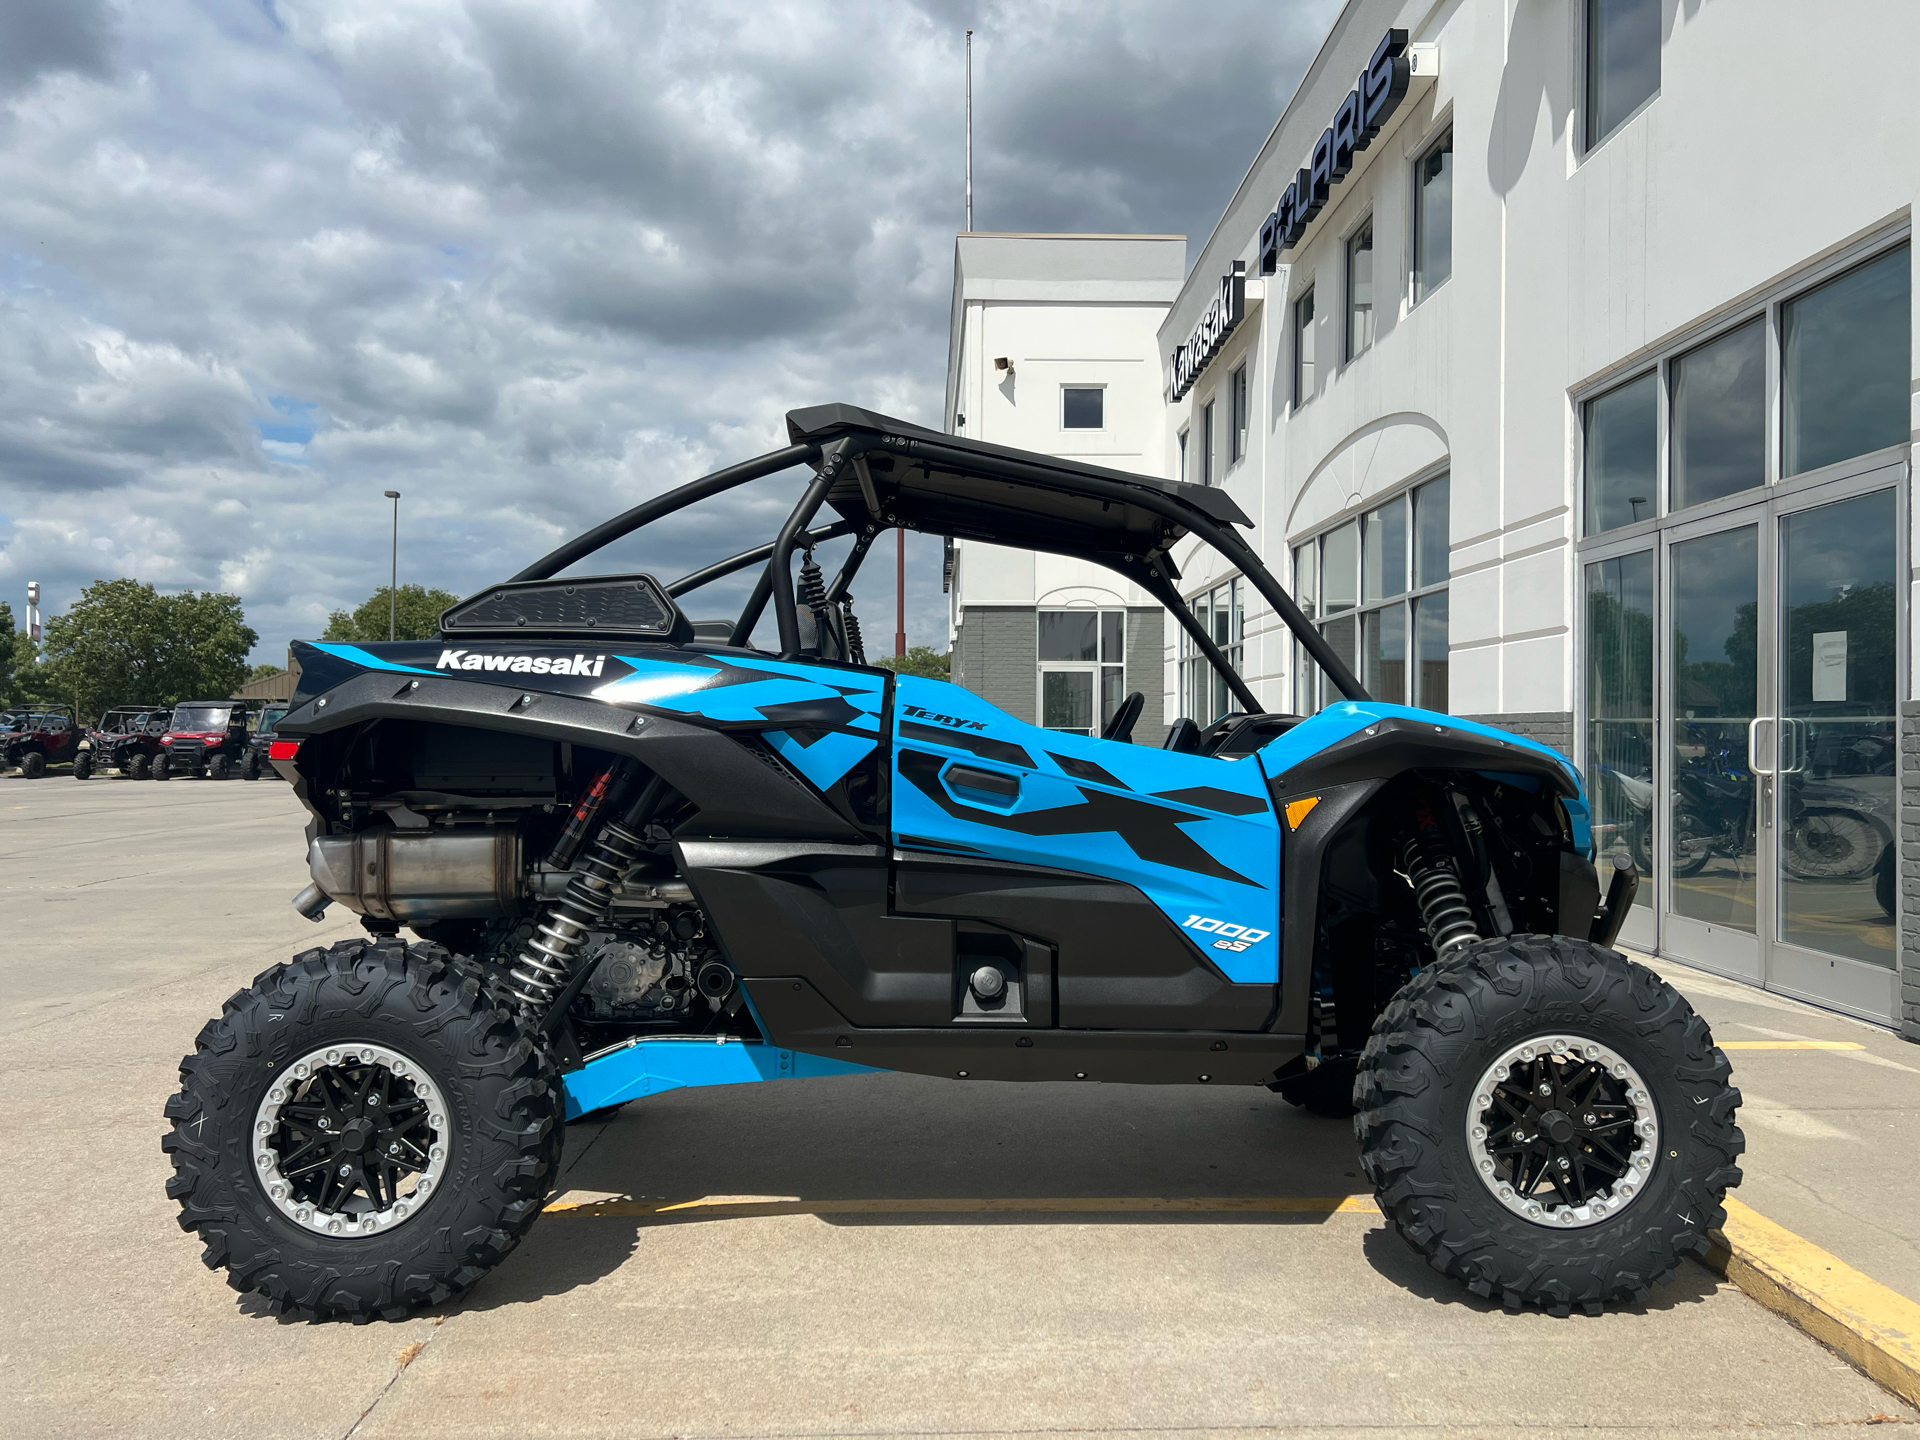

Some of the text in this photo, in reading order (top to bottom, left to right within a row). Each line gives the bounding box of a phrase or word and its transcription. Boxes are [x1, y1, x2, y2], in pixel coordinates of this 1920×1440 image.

[1169, 260, 1246, 403] Kawasaki
[436, 650, 605, 677] Kawasaki
[1183, 914, 1271, 943] 1000
[1485, 1013, 1603, 1049] CARNIVORE
[444, 1075, 471, 1199] CARNIVORE
